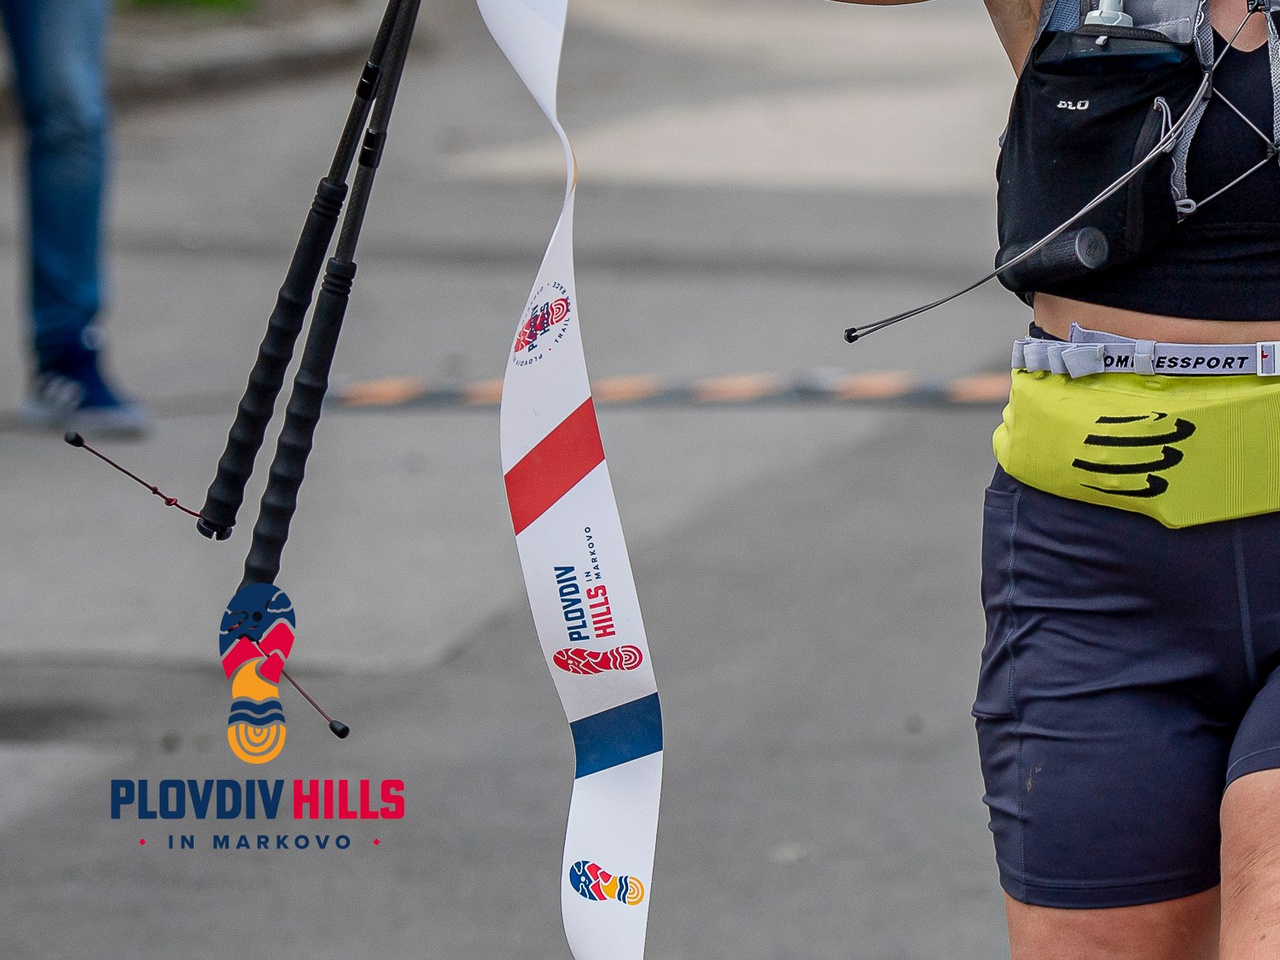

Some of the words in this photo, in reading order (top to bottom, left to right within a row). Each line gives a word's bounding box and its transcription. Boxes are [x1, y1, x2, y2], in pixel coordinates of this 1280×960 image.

[584, 526, 602, 580] MARKOVO
[584, 571, 593, 583] IN
[554, 566, 590, 642] PLOVDIV
[586, 584, 616, 639] HILLS
